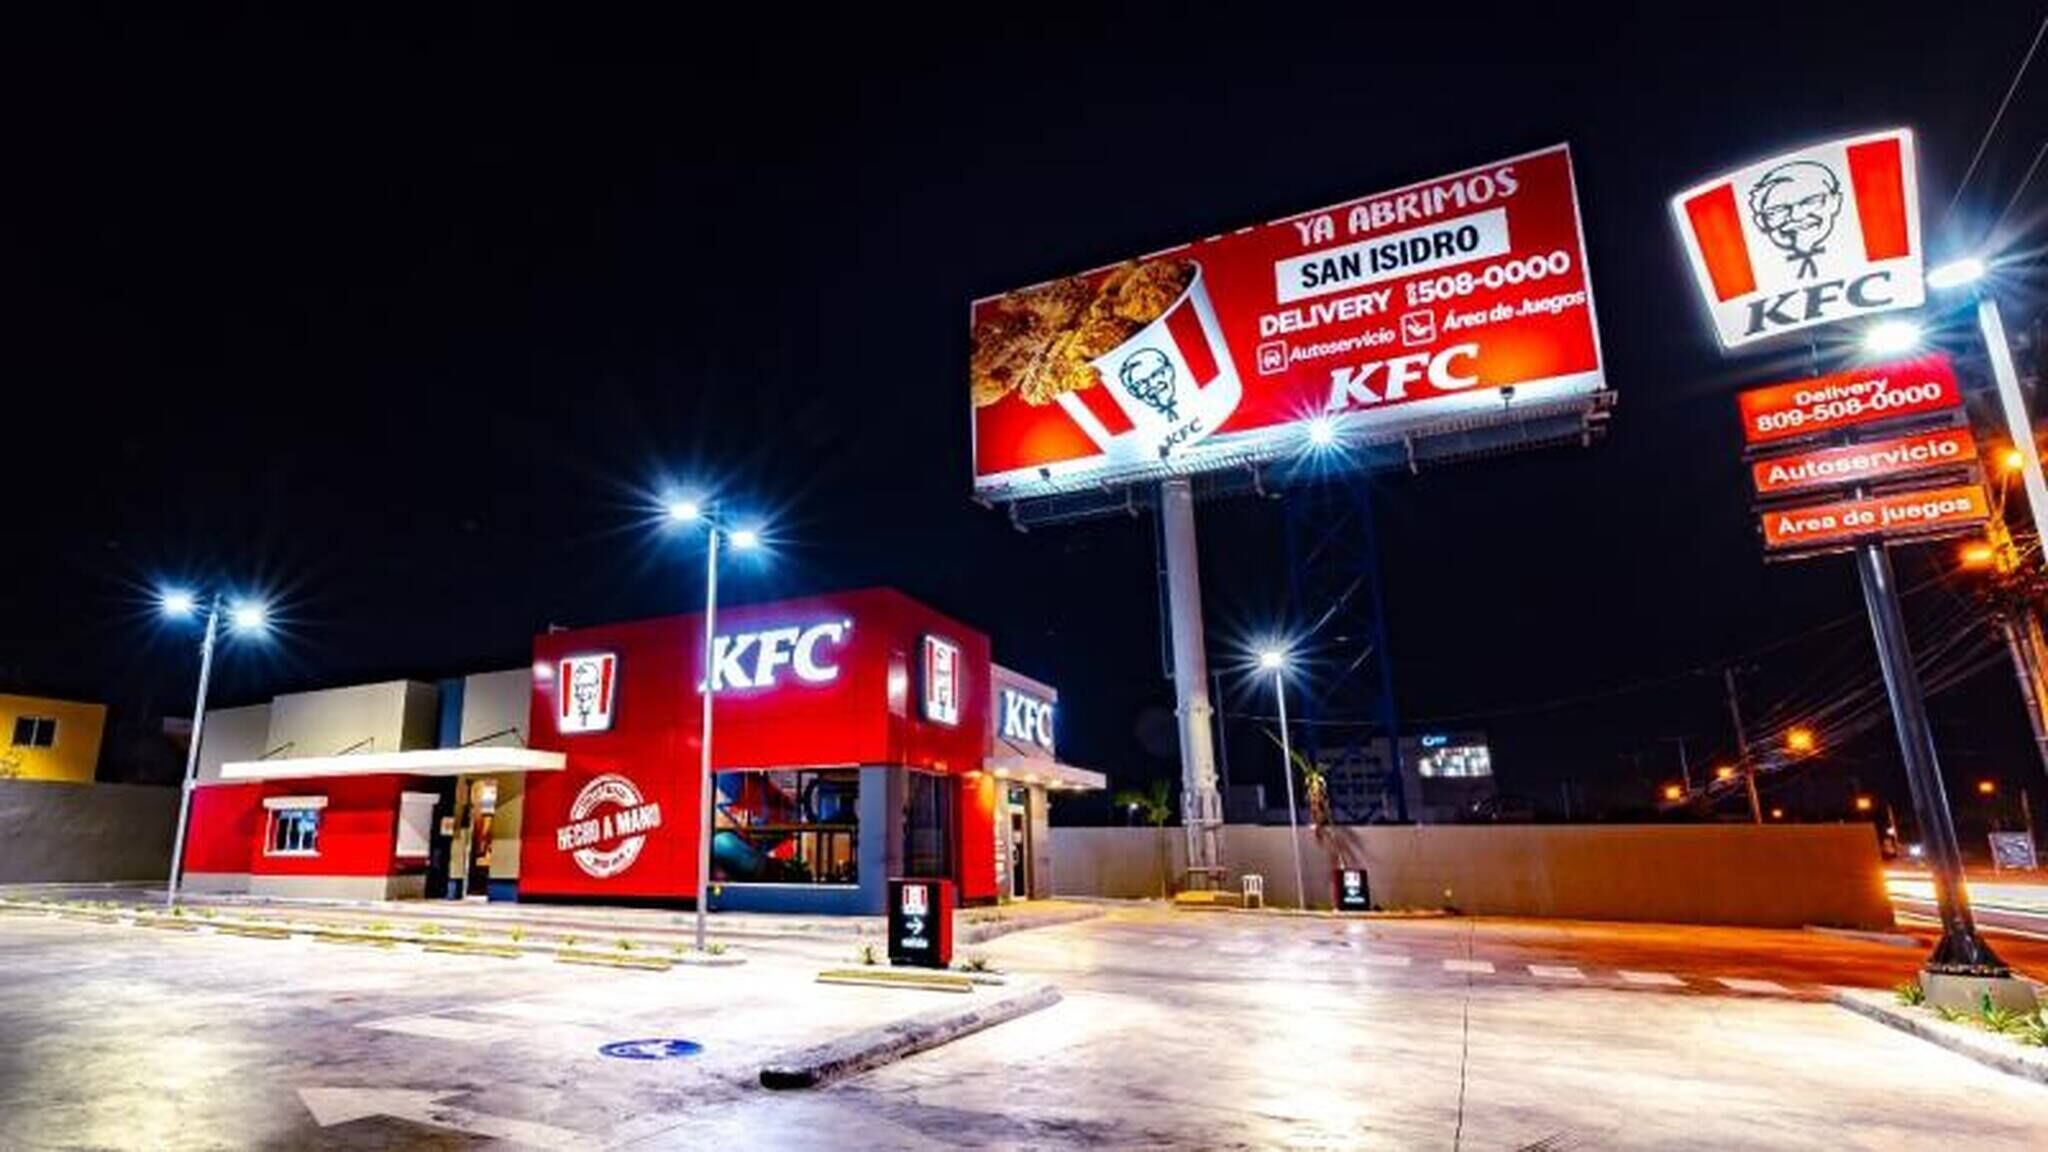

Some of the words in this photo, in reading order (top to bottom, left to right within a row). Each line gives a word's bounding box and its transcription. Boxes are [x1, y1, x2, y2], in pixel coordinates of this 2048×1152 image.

[1294, 214, 1334, 246] YA
[1348, 166, 1518, 235] ABRIMOS
[1301, 252, 1361, 289] SAN
[1371, 225, 1479, 274] ISIDRO
[1259, 289, 1393, 337] DELIVERY
[1442, 310, 1487, 332] Área
[1490, 299, 1513, 321] de
[1516, 290, 1586, 316] Juegos
[1744, 270, 1895, 337] KFC
[1289, 328, 1396, 363] Autoservicio
[1325, 343, 1480, 411] KFC
[1794, 376, 1889, 407] Delivery
[1757, 382, 1942, 432] 809-508-0000
[1767, 440, 1960, 485] Autoservicio
[1777, 509, 1836, 536] Área
[1843, 505, 1875, 528] de
[1880, 497, 1972, 526] juegos
[697, 623, 844, 693] KFC
[1004, 690, 1054, 747] KFC
[603, 815, 614, 841] A
